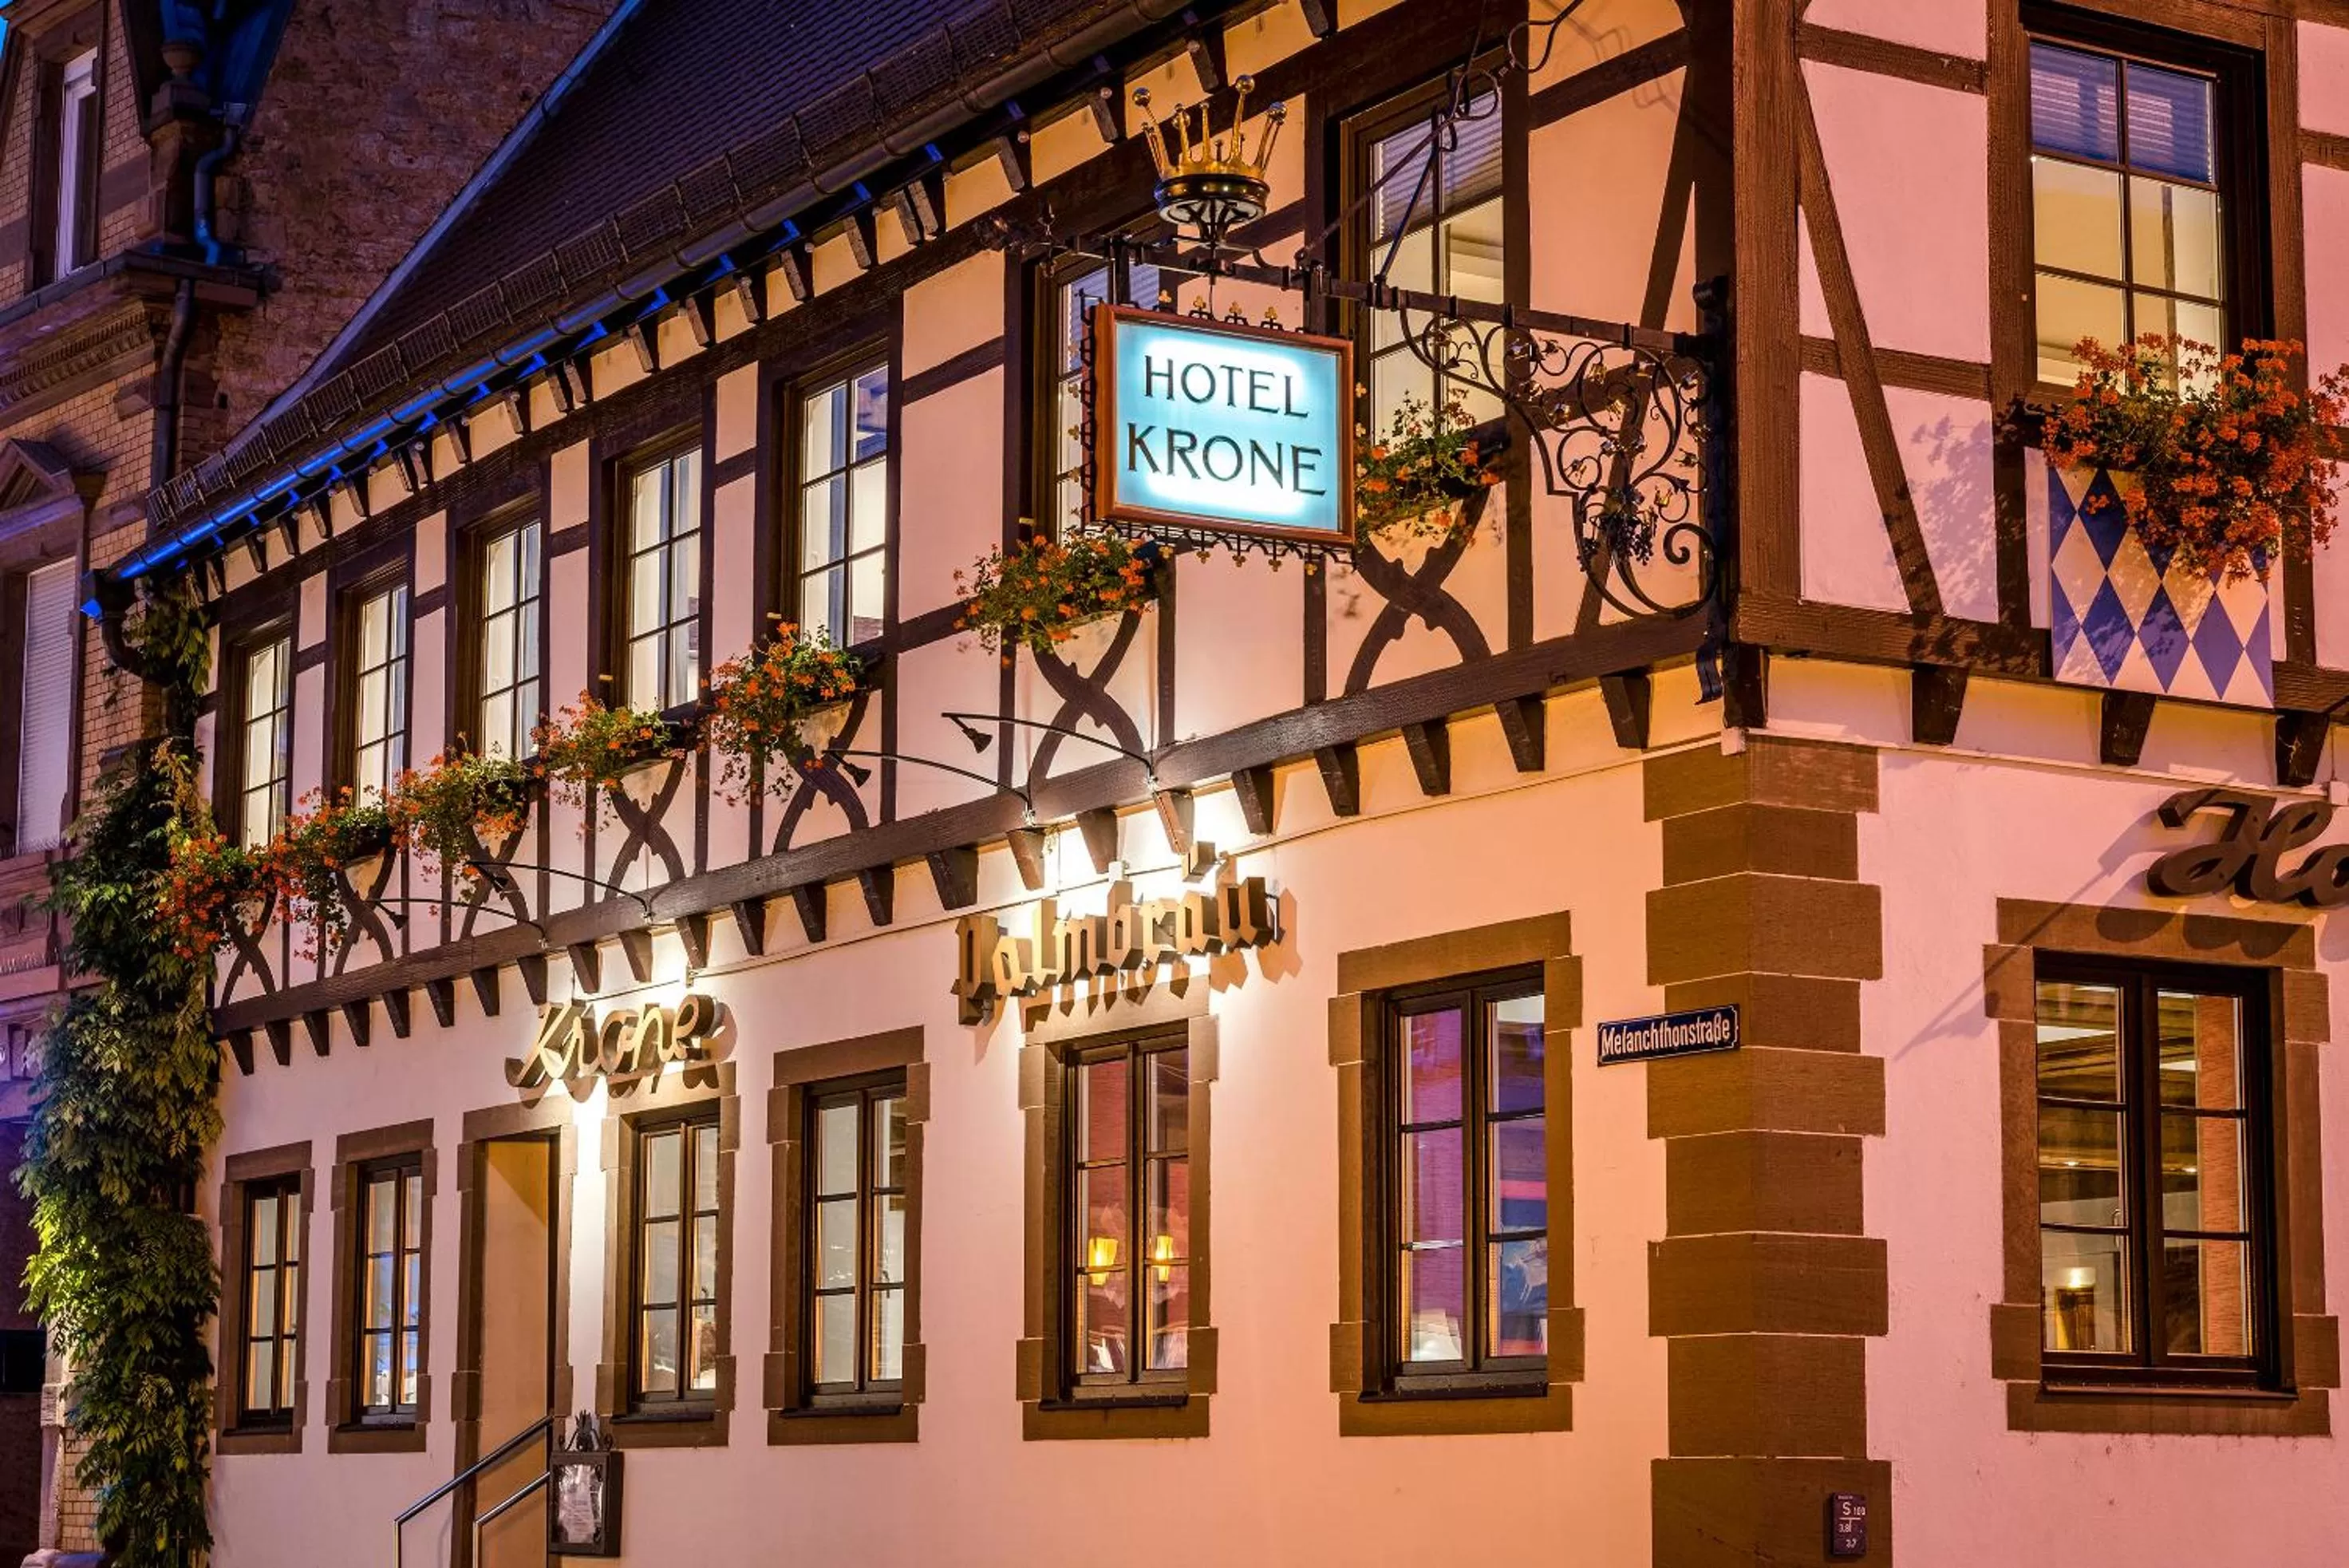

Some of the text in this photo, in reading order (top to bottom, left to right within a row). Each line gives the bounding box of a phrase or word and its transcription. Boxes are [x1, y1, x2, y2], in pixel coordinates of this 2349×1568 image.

[1144, 354, 1309, 419] HOTEL
[1127, 422, 1326, 496] KRONE
[506, 994, 717, 1088] Krone
[1601, 1011, 1731, 1057] Melanchthonstraße
[1842, 1502, 1851, 1515] S
